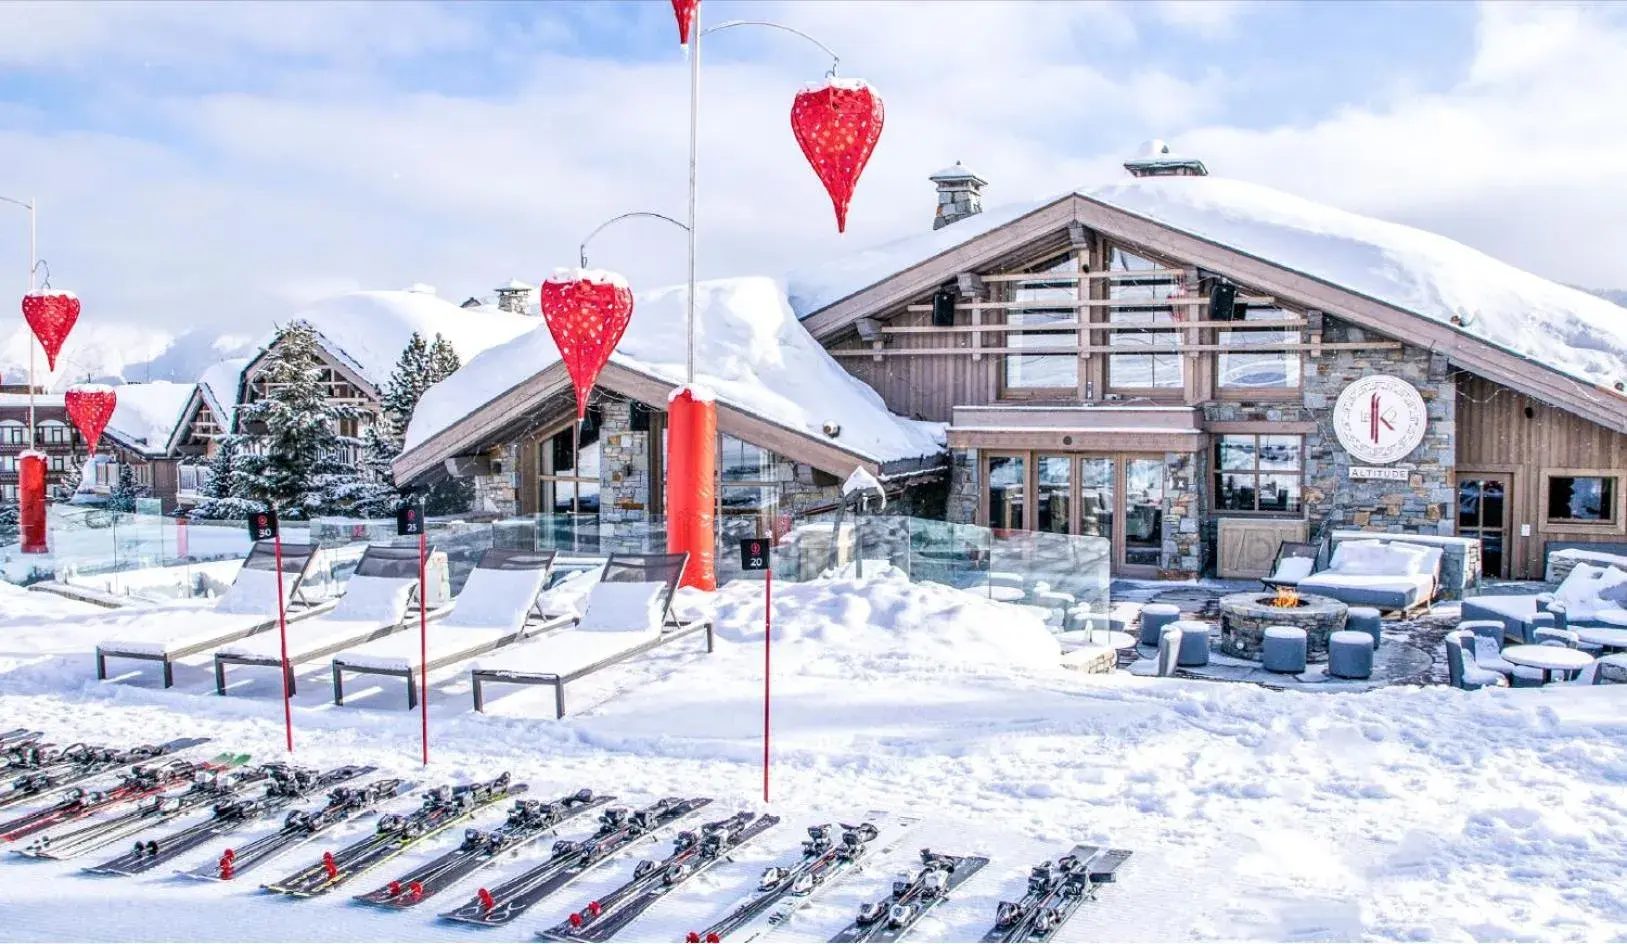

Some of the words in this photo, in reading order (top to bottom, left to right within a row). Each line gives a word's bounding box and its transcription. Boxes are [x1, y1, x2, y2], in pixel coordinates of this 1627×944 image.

[1351, 468, 1407, 479] ALTITUDE
[407, 523, 418, 532] 25
[258, 528, 272, 538] 30
[749, 557, 763, 567] 20
